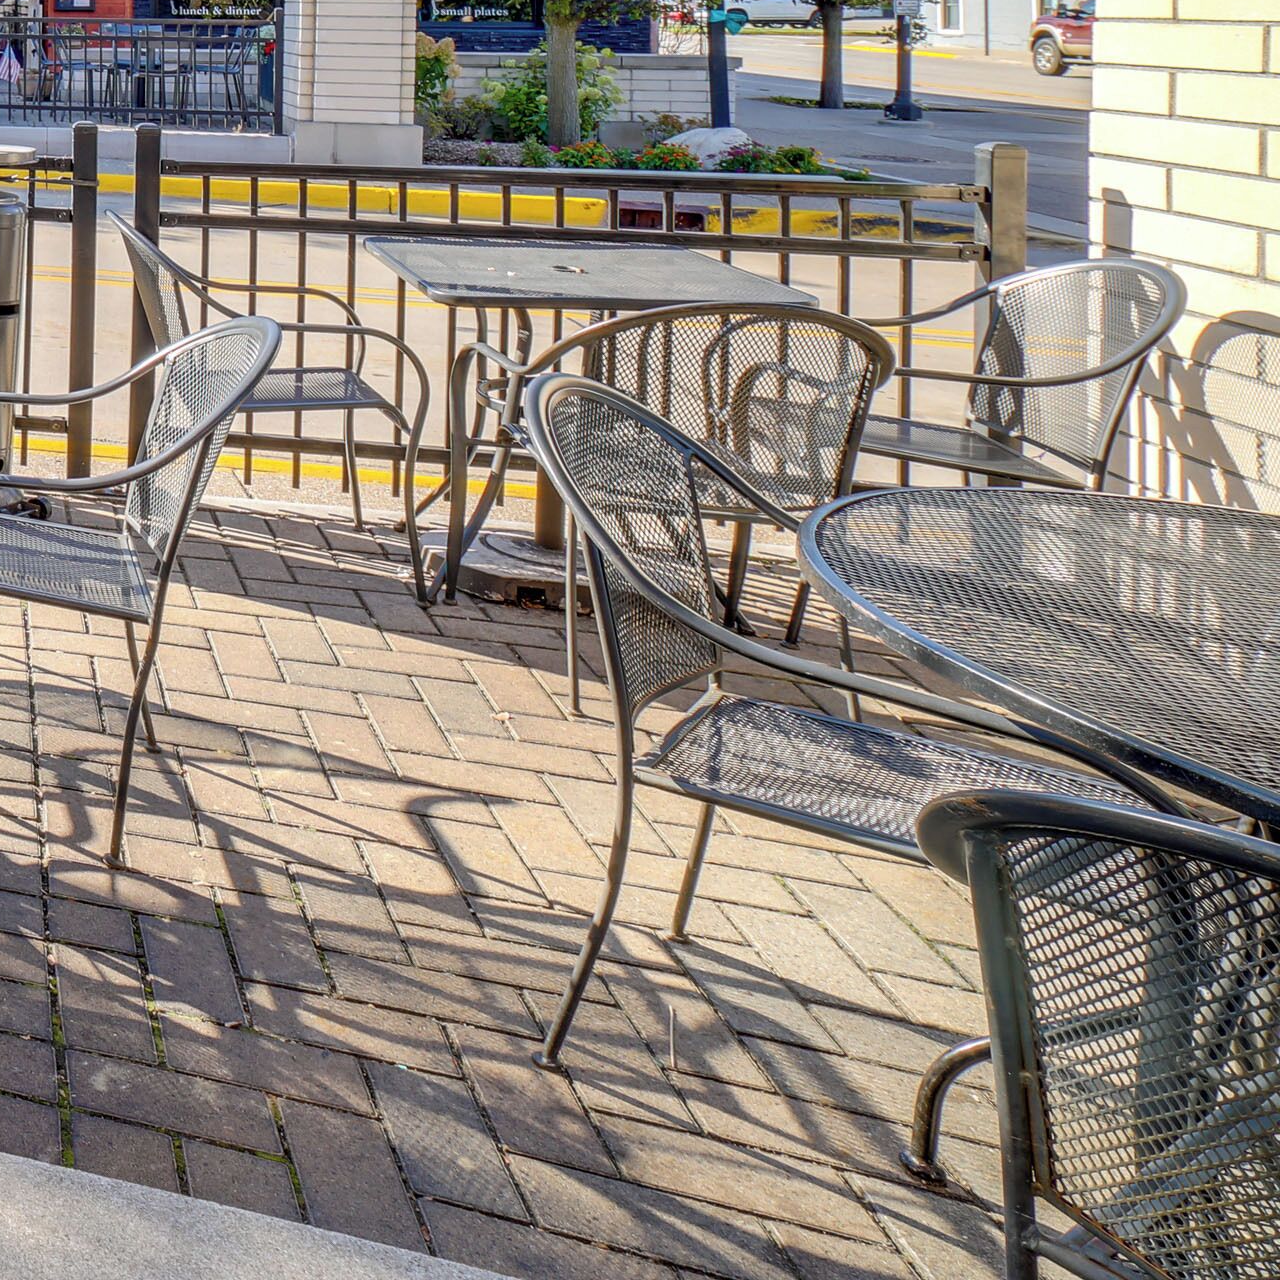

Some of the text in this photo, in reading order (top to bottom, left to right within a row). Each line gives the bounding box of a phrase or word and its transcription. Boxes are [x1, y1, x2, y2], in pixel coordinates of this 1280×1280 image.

[179, 6, 262, 15] lunch & dinner
[440, 6, 509, 18] small plates
